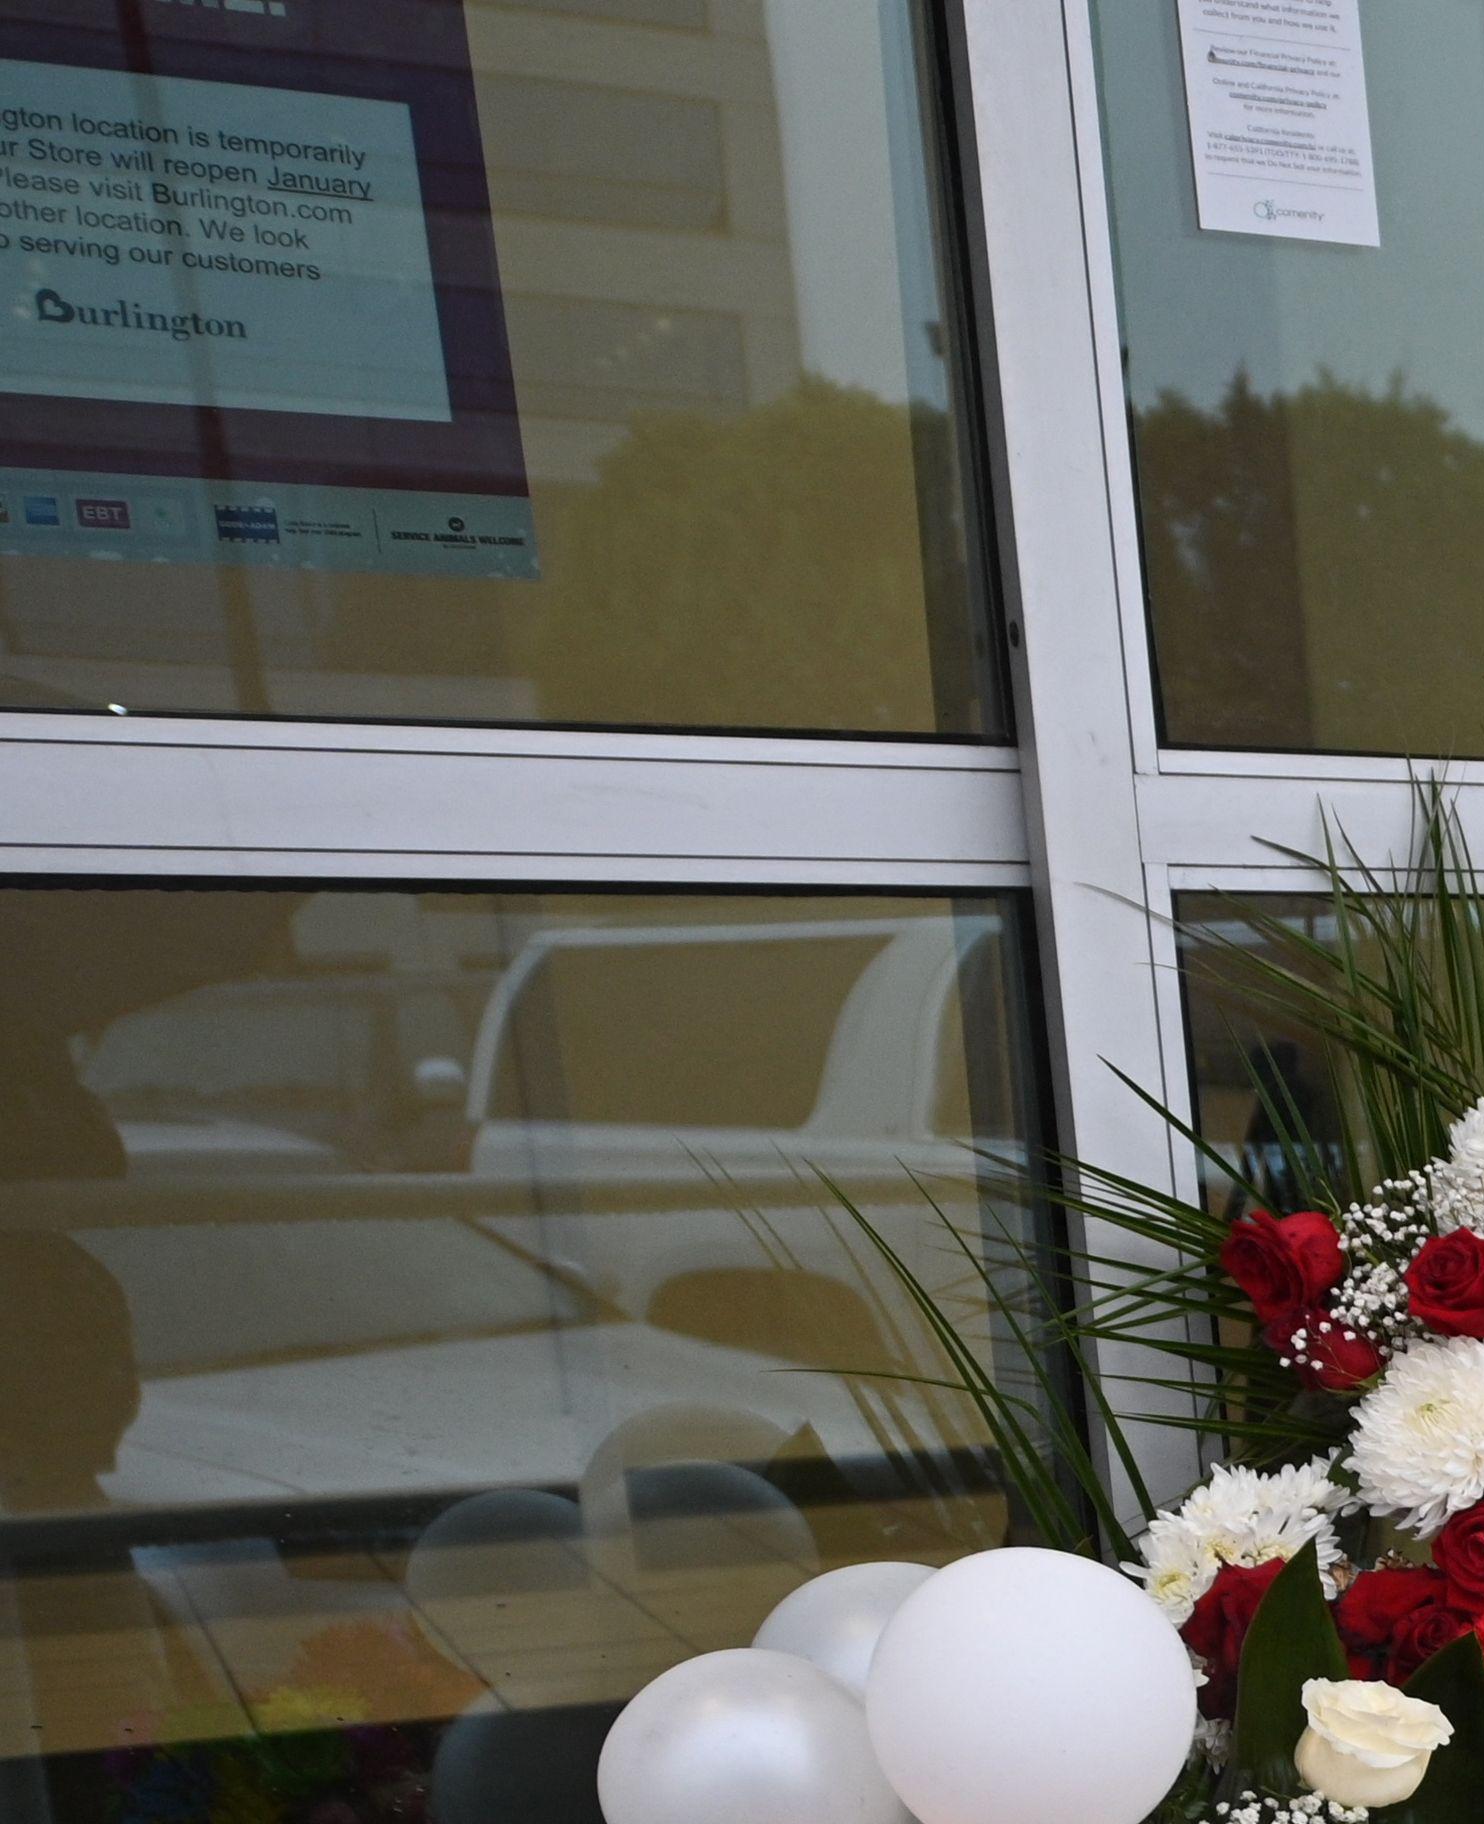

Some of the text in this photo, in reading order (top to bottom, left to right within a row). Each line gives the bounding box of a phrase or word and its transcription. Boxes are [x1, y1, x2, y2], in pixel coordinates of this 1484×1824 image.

[0, 107, 366, 171] gton location is temporarily
[28, 137, 102, 166] Store
[112, 149, 154, 173] will
[164, 156, 258, 184] reopen
[267, 166, 372, 199] January
[90, 180, 142, 201] visit
[151, 183, 353, 226] Burlington.com
[76, 206, 190, 238] location.
[199, 218, 245, 243] We
[255, 221, 310, 250] look
[19, 232, 119, 265] serving
[129, 245, 173, 266] our
[182, 249, 322, 281] customers
[34, 288, 247, 342] Burlington
[81, 504, 124, 523] EBT
